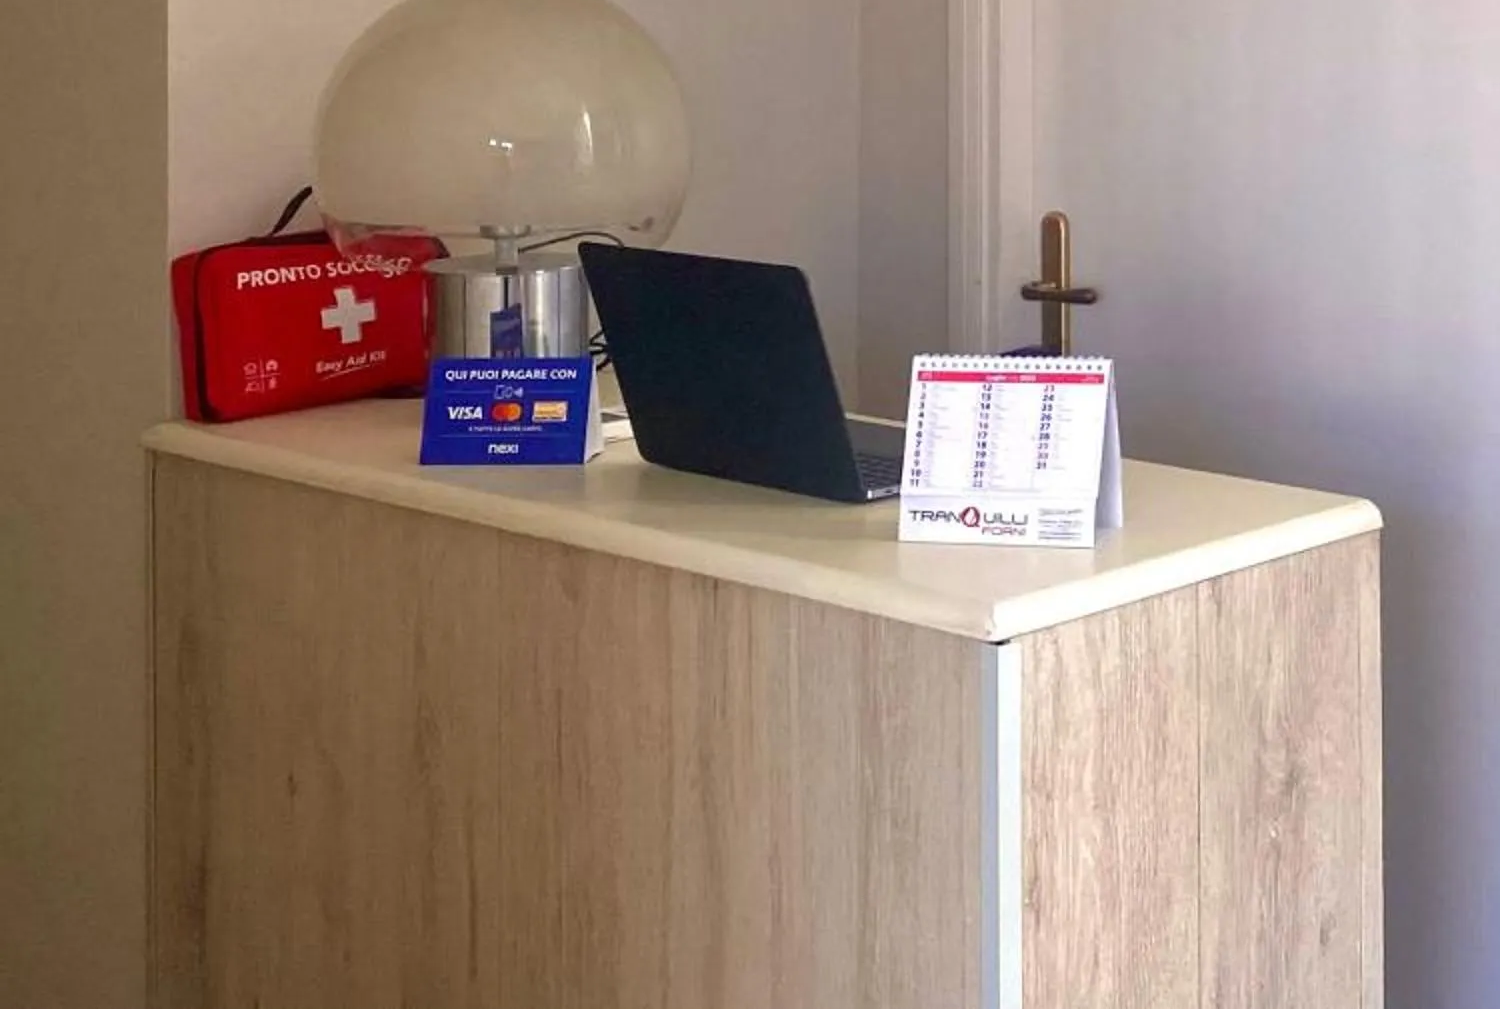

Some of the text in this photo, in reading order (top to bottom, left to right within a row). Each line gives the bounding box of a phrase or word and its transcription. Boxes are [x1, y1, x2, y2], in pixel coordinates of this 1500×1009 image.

[237, 263, 321, 290] PRONTO
[315, 358, 343, 374] Easy
[346, 352, 367, 366] Aid
[445, 369, 577, 381] QUI PUOI PAGARE CON
[447, 405, 483, 420] VISA
[487, 442, 519, 455] nexi
[981, 526, 1027, 537] FORNI
